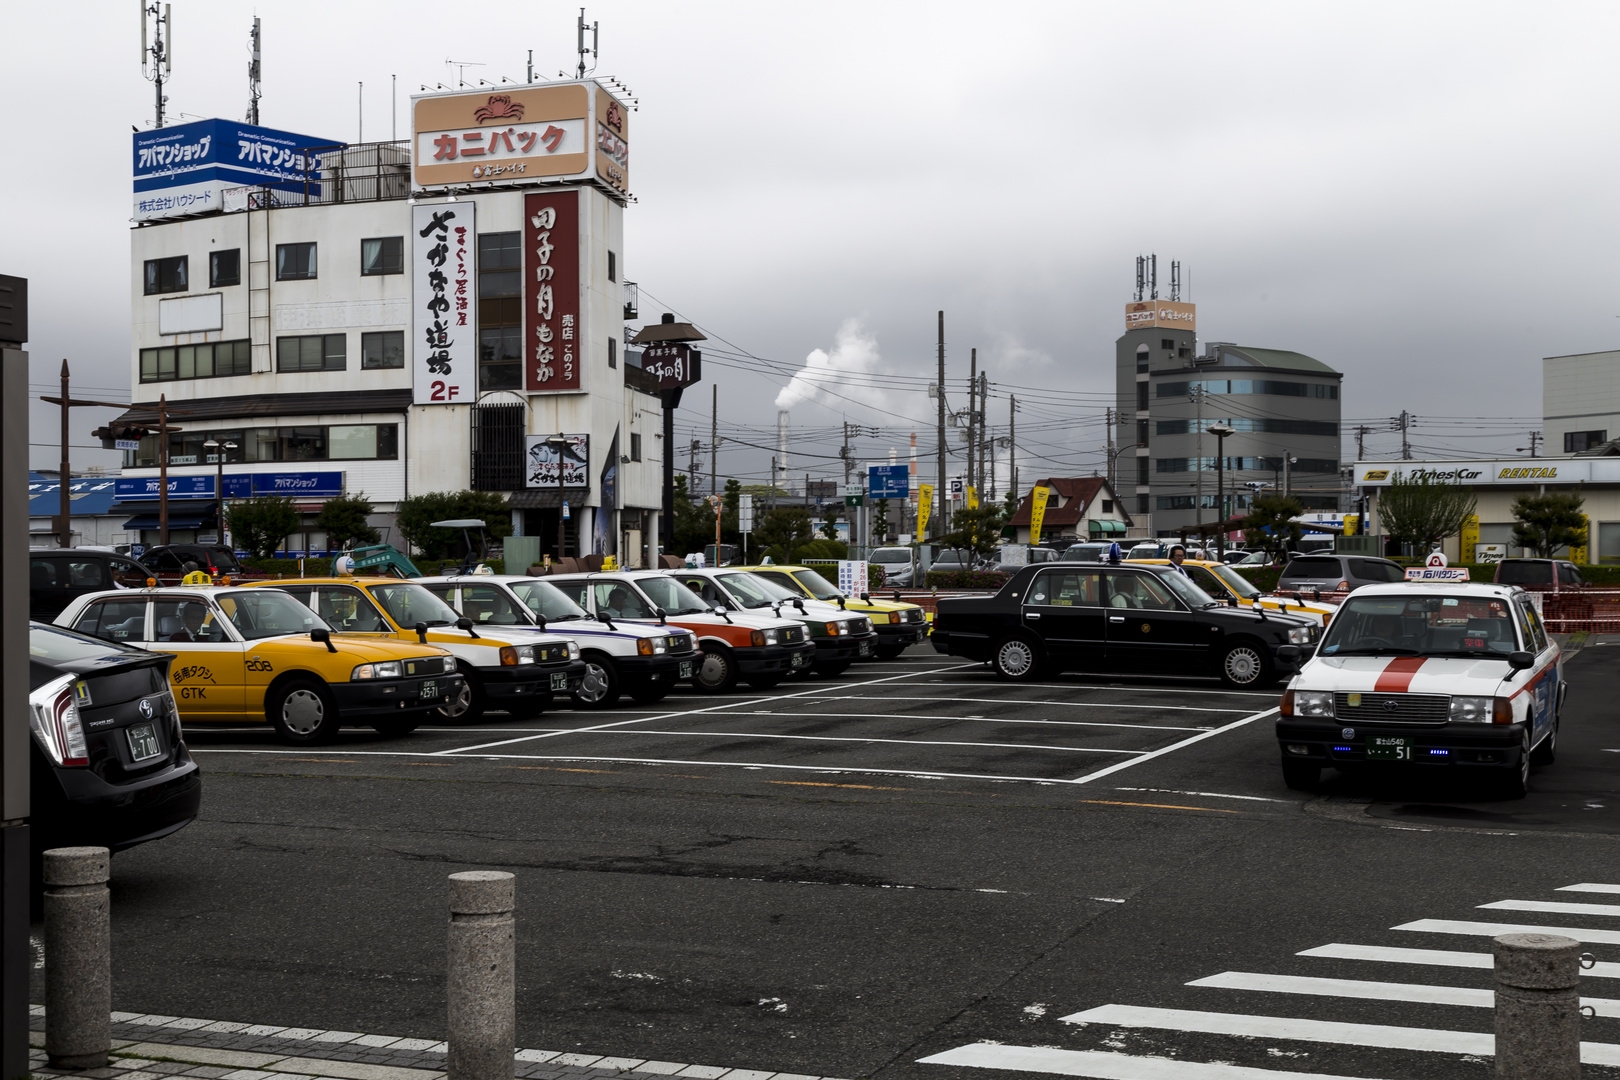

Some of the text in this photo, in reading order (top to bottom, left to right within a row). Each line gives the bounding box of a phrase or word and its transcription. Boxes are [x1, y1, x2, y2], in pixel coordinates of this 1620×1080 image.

[238, 131, 296, 146] Dramatic Communication
[433, 124, 567, 161] カニパック
[138, 134, 211, 168] アパマンショップ
[483, 162, 527, 177] 富士バイオ
[138, 190, 212, 213] 株式会社ハウシード
[454, 226, 469, 326] まぐろ居酒屋
[420, 210, 456, 376] さかなや道場
[562, 314, 574, 381] 売店 このウラ
[430, 380, 460, 401] 2F
[1410, 468, 1483, 480] Times Car
[1498, 467, 1558, 478] RENTAL
[274, 478, 318, 488] アパマンショップ
[952, 482, 960, 492] P
[1422, 570, 1466, 579] 石川タクシー
[173, 666, 216, 684] 岳南タクシー
[181, 688, 207, 699] GTK
